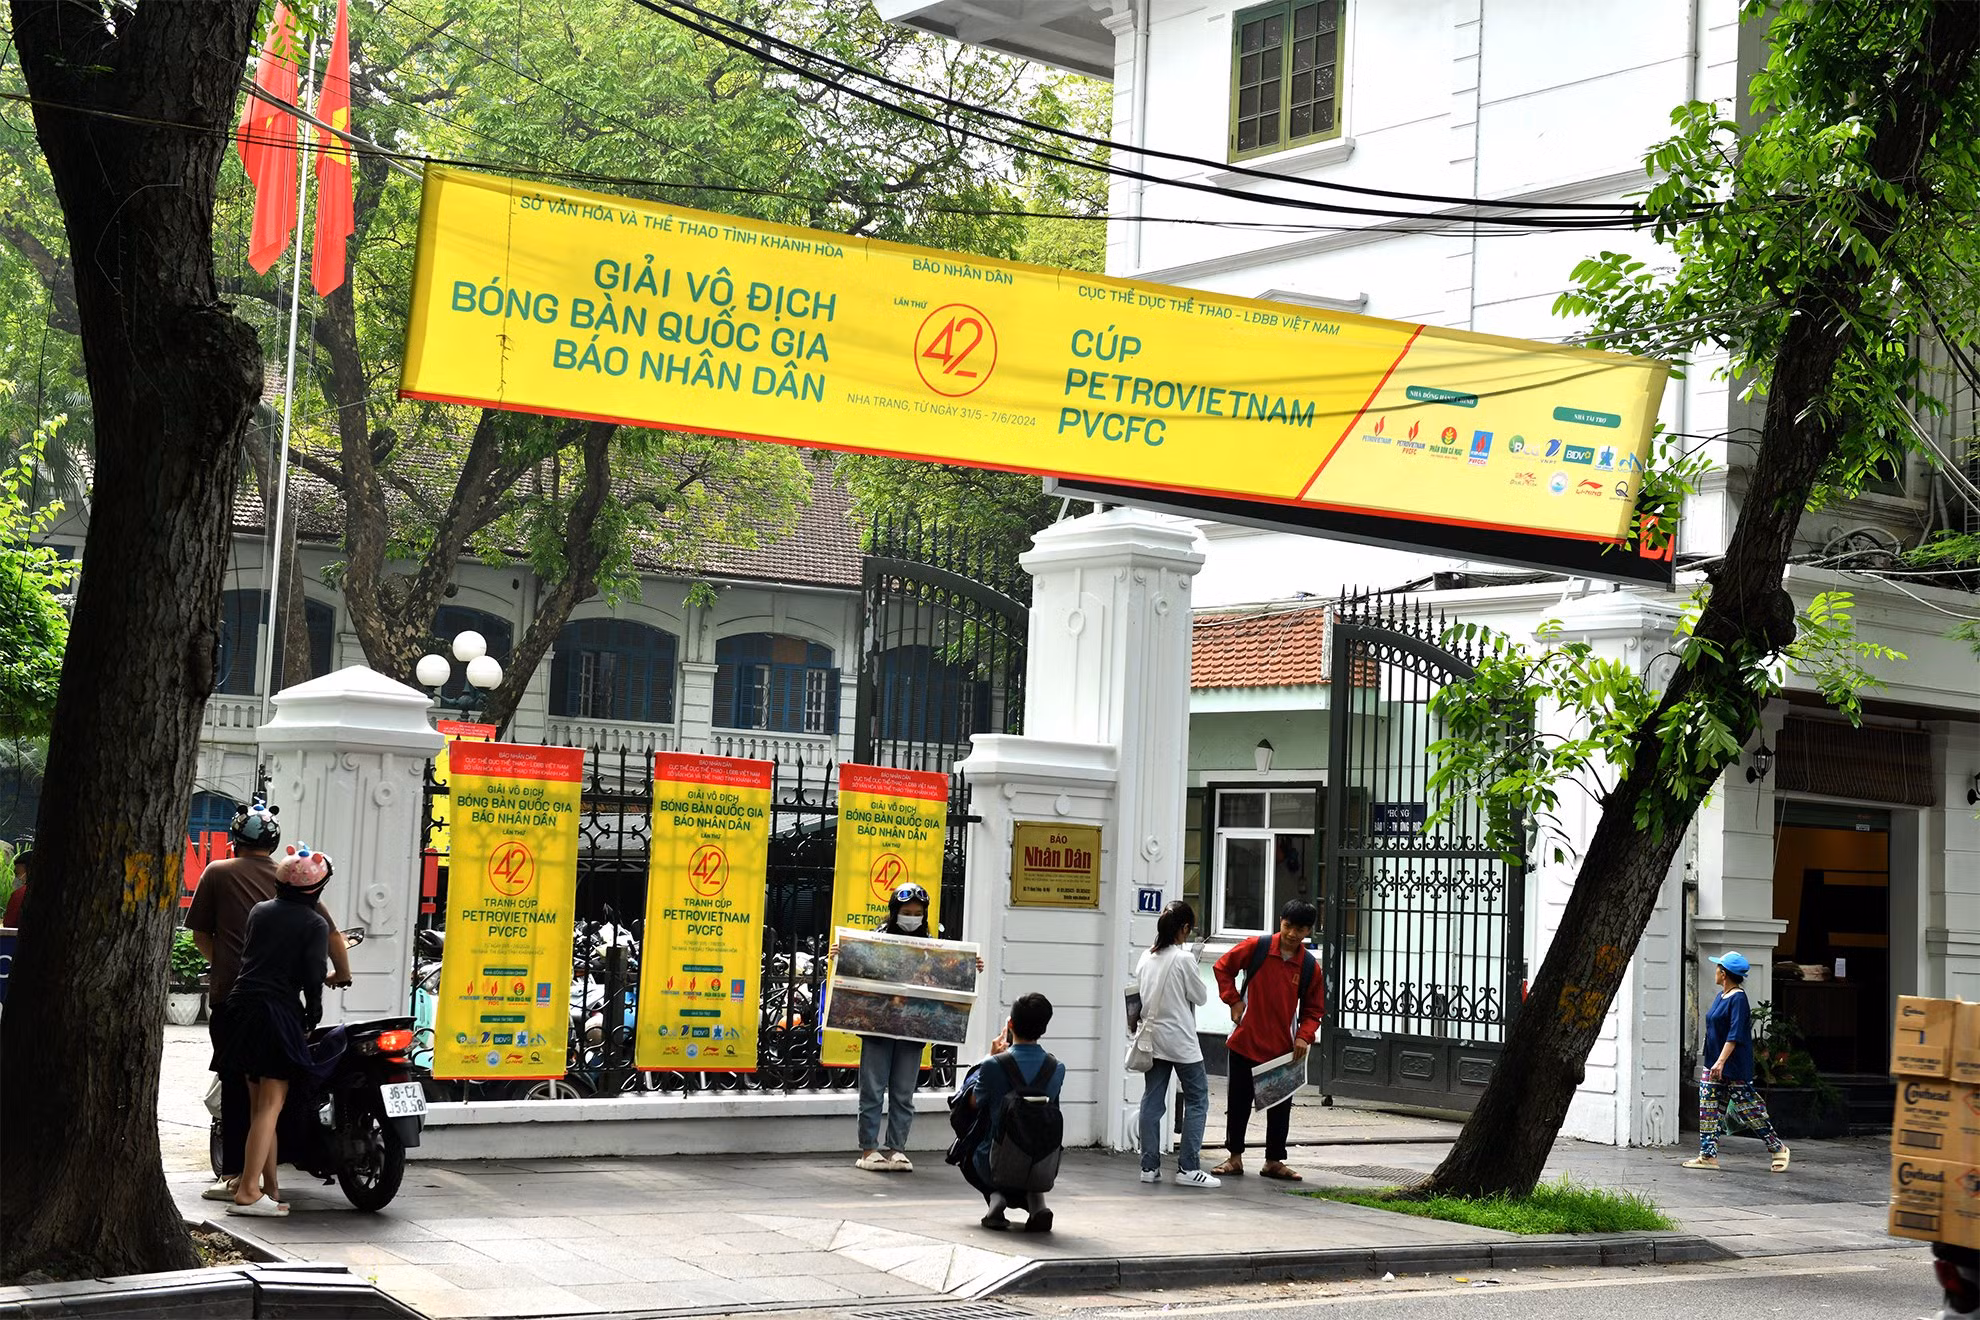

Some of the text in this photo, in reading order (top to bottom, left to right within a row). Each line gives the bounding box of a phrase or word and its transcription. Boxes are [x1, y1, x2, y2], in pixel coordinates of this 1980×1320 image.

[520, 194, 544, 210] SỞ
[548, 198, 578, 216] VĂN
[582, 205, 613, 222] HÓA
[620, 210, 637, 225] VÀ
[678, 221, 718, 238] THAO
[761, 236, 811, 254] KHÁNH
[815, 242, 843, 258] HÒA
[913, 259, 1013, 285] BÁO NHÂN DÂN
[594, 254, 836, 322] GIẢI VÔ ĐỊCH
[452, 277, 830, 363] BÓNG BÀN QUỐC GIA
[1079, 286, 1106, 300] CỤC
[1110, 288, 1134, 304] THỂ
[1139, 295, 1166, 309] DỤC
[1170, 297, 1194, 313] THỂ
[1198, 304, 1232, 318] THAO
[1244, 312, 1278, 326] LĐBB
[1282, 316, 1310, 332] VIỆT
[1312, 322, 1340, 335] NAM
[922, 316, 983, 378] 42
[1071, 325, 1141, 363] CÚP
[553, 336, 826, 403] BÁO NHÂN DÂN
[1064, 368, 1316, 428] PETROVIETNAM
[847, 393, 870, 405] NHA
[873, 396, 910, 412] TRANG,
[914, 400, 929, 412] TỪ
[930, 404, 958, 416] NGÀY
[960, 408, 981, 420] 31/5
[992, 412, 1036, 427] 7/6/2024
[1058, 407, 1167, 447] PVCFC
[1566, 450, 1584, 460] BIDV
[488, 784, 544, 798] GIẢI VÔ ĐỊCH
[688, 789, 739, 804] GIẢI VÔ ĐỊCH
[457, 792, 572, 813] BÓNG BÀN QUỐC GIA
[660, 798, 763, 818] BÓNG BÀN QUỐC GIA
[871, 801, 916, 814] GIẢI VÔ ĐỊCH
[472, 810, 556, 826] BÁO NHÂN DÂN
[674, 814, 750, 831] BÁO NHÂN DÂN
[846, 808, 940, 829] BÓNG BÀN QUỐC GIA
[858, 823, 927, 841] BÁO NHÂN DÂN
[1050, 833, 1068, 844] BÁO
[494, 849, 526, 883] 42
[1024, 846, 1091, 869] Nhân Dân
[693, 852, 722, 885] 42
[874, 860, 901, 891] 42
[484, 898, 537, 908] TRANH CÚP
[684, 898, 732, 908] TRANH CÚP
[866, 904, 890, 912] TRAN
[1143, 893, 1157, 909] 71
[462, 910, 556, 924] PETROVIETNAM
[664, 910, 750, 923] PETROVIETNAM
[489, 926, 527, 938] PVCFC
[688, 925, 723, 936] PVCFC
